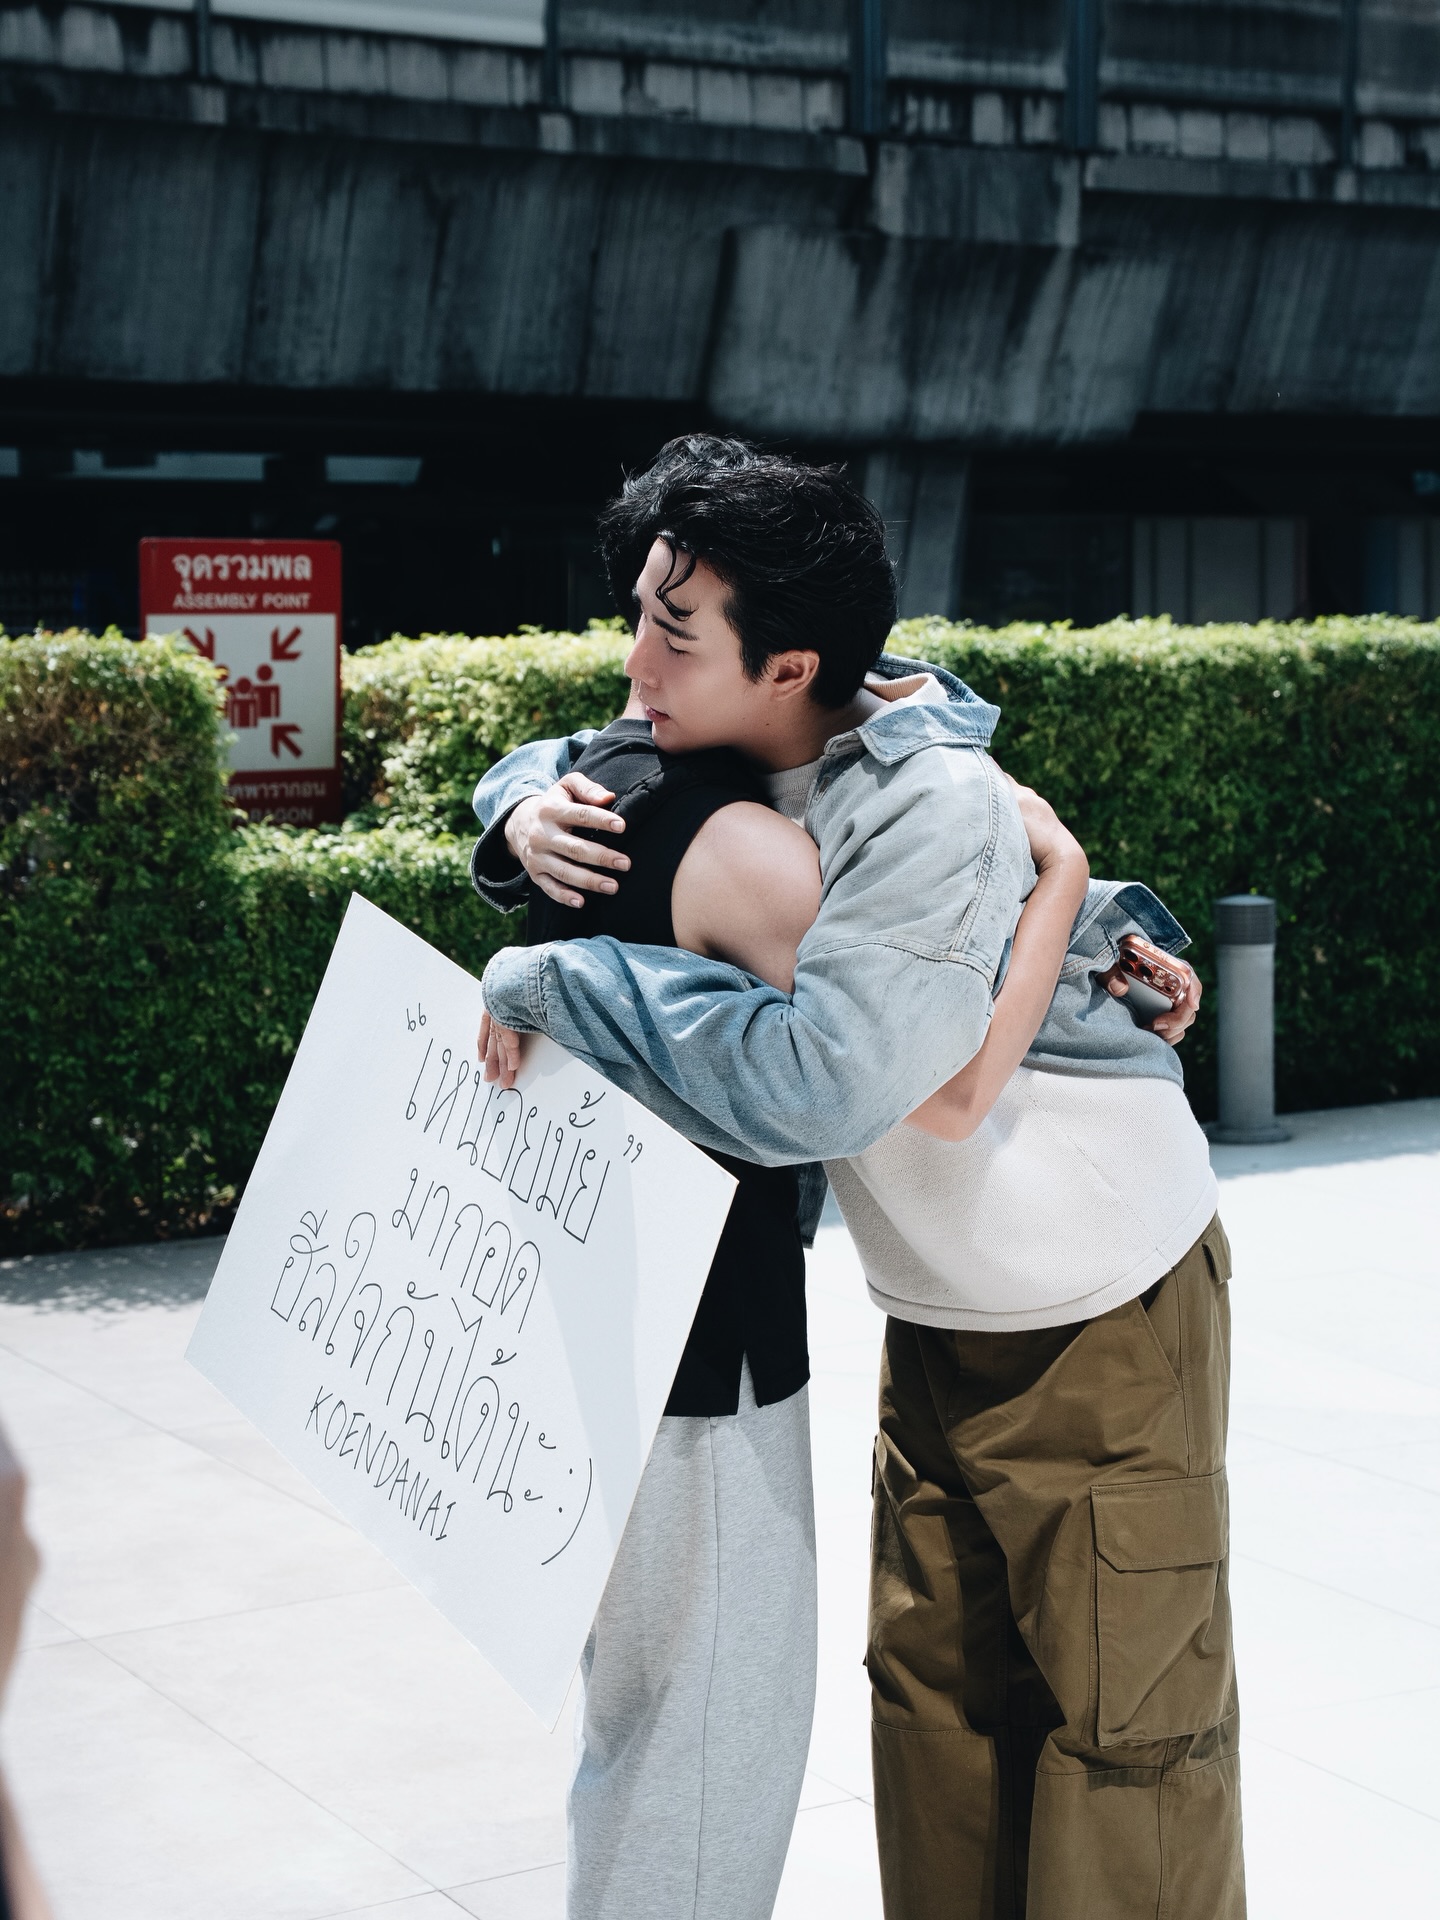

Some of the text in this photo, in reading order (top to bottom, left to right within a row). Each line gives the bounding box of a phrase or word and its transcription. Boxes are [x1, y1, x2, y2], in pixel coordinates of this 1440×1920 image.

[171, 554, 313, 592] จุดรวมพล
[172, 592, 312, 609] ASSEMBLY POINT
[391, 1168, 541, 1334] มากอด
[305, 1385, 456, 1541] KOENDANAI
